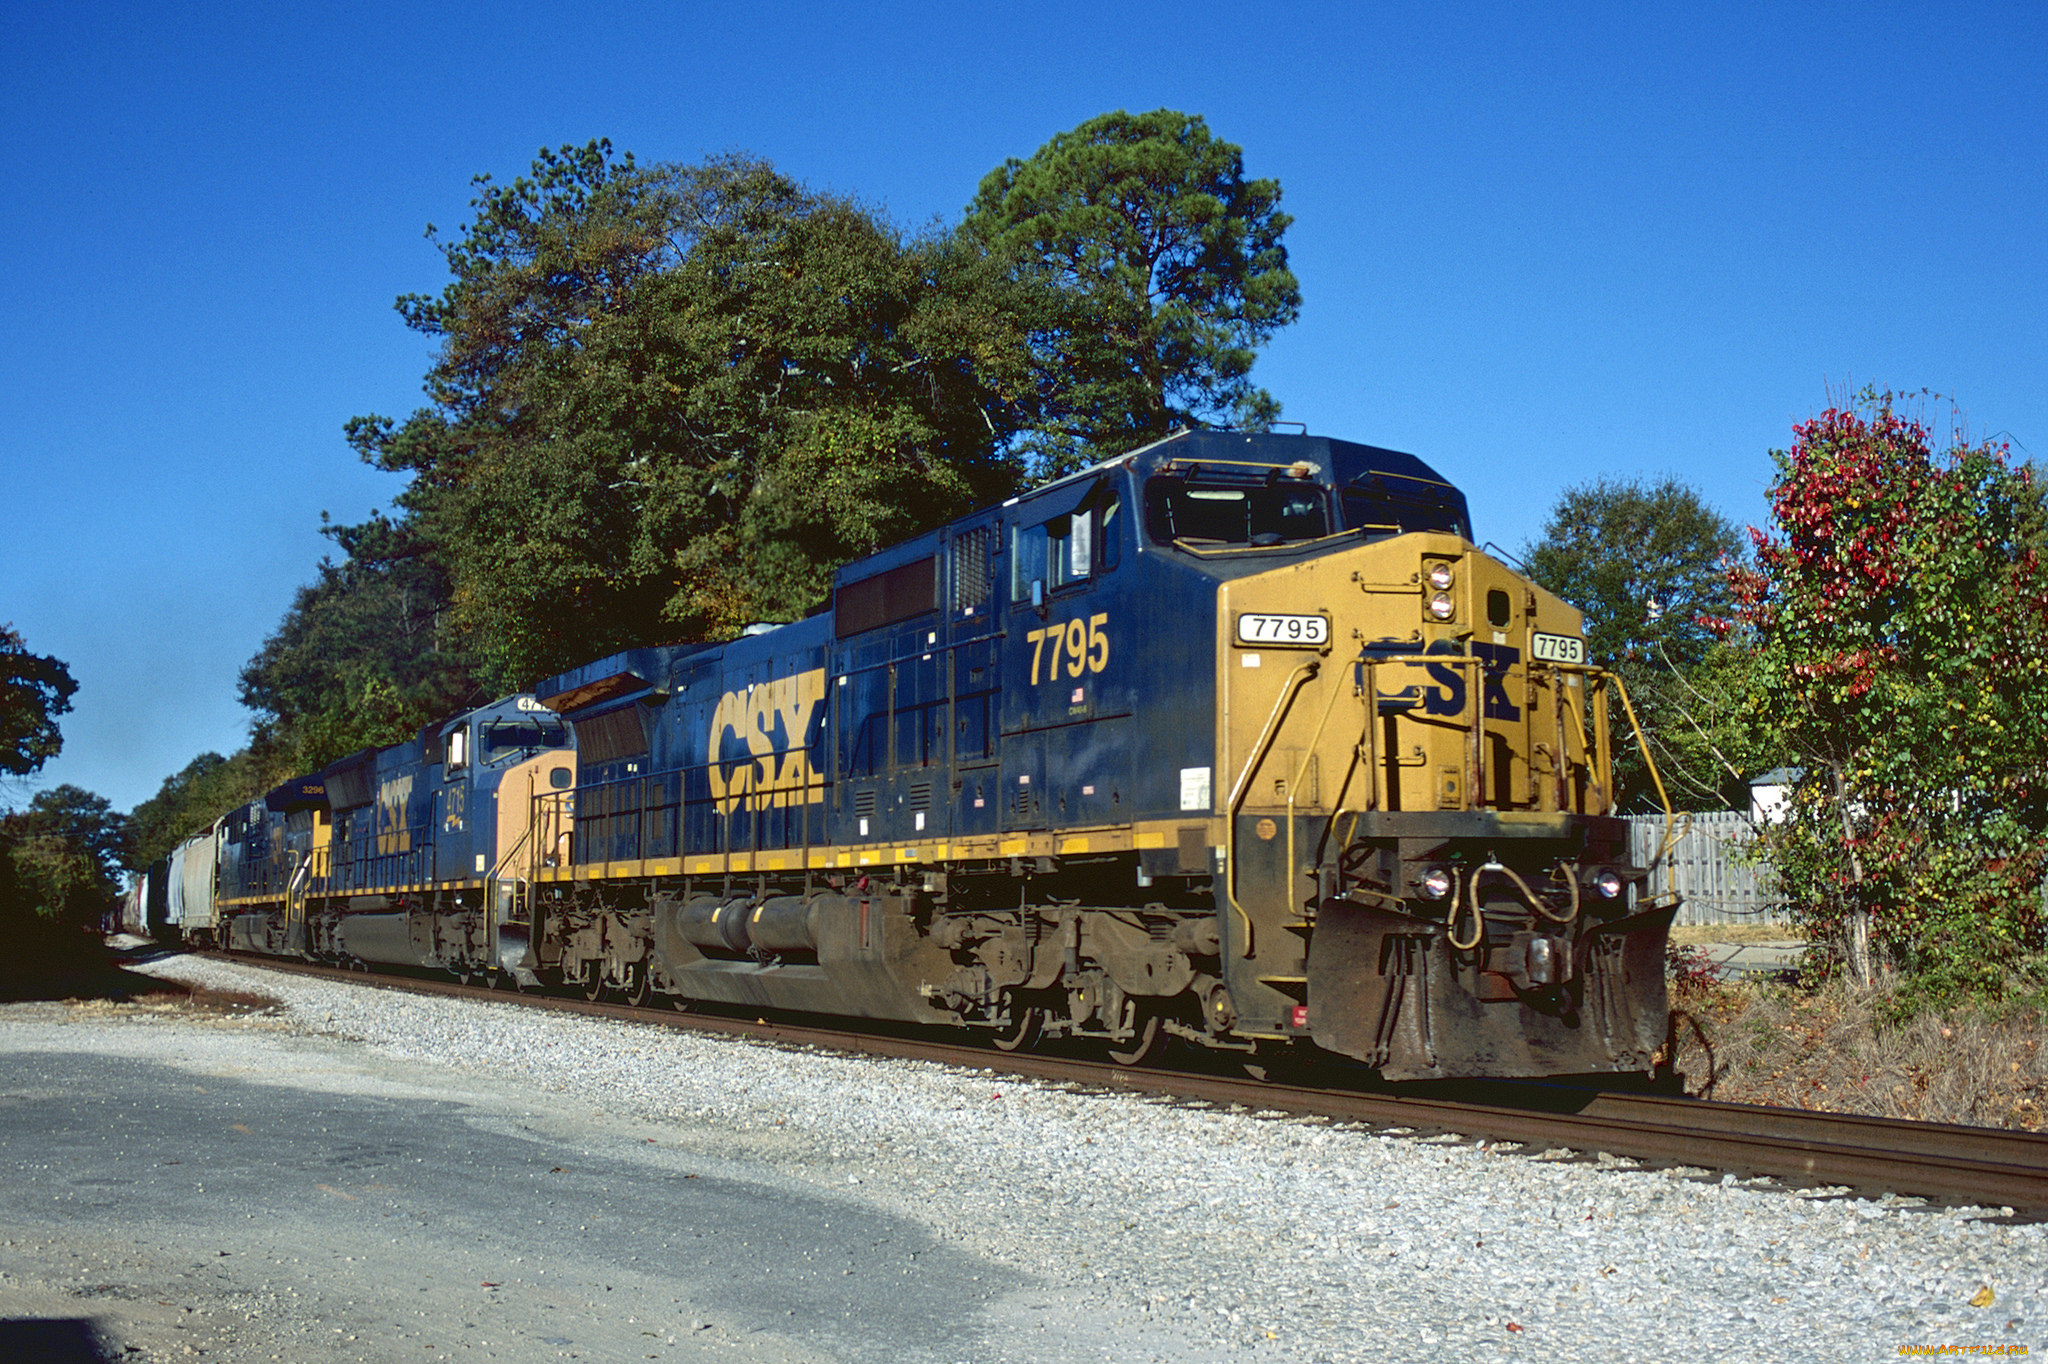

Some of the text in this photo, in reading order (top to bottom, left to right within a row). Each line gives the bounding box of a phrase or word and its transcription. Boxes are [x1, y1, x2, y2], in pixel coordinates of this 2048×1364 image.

[1026, 612, 1109, 686] 7795
[1253, 618, 1319, 639] 7795
[1538, 637, 1578, 660] 7795
[1354, 636, 1520, 722] CSX
[708, 667, 825, 816] CSX
[377, 775, 412, 856] CSX
